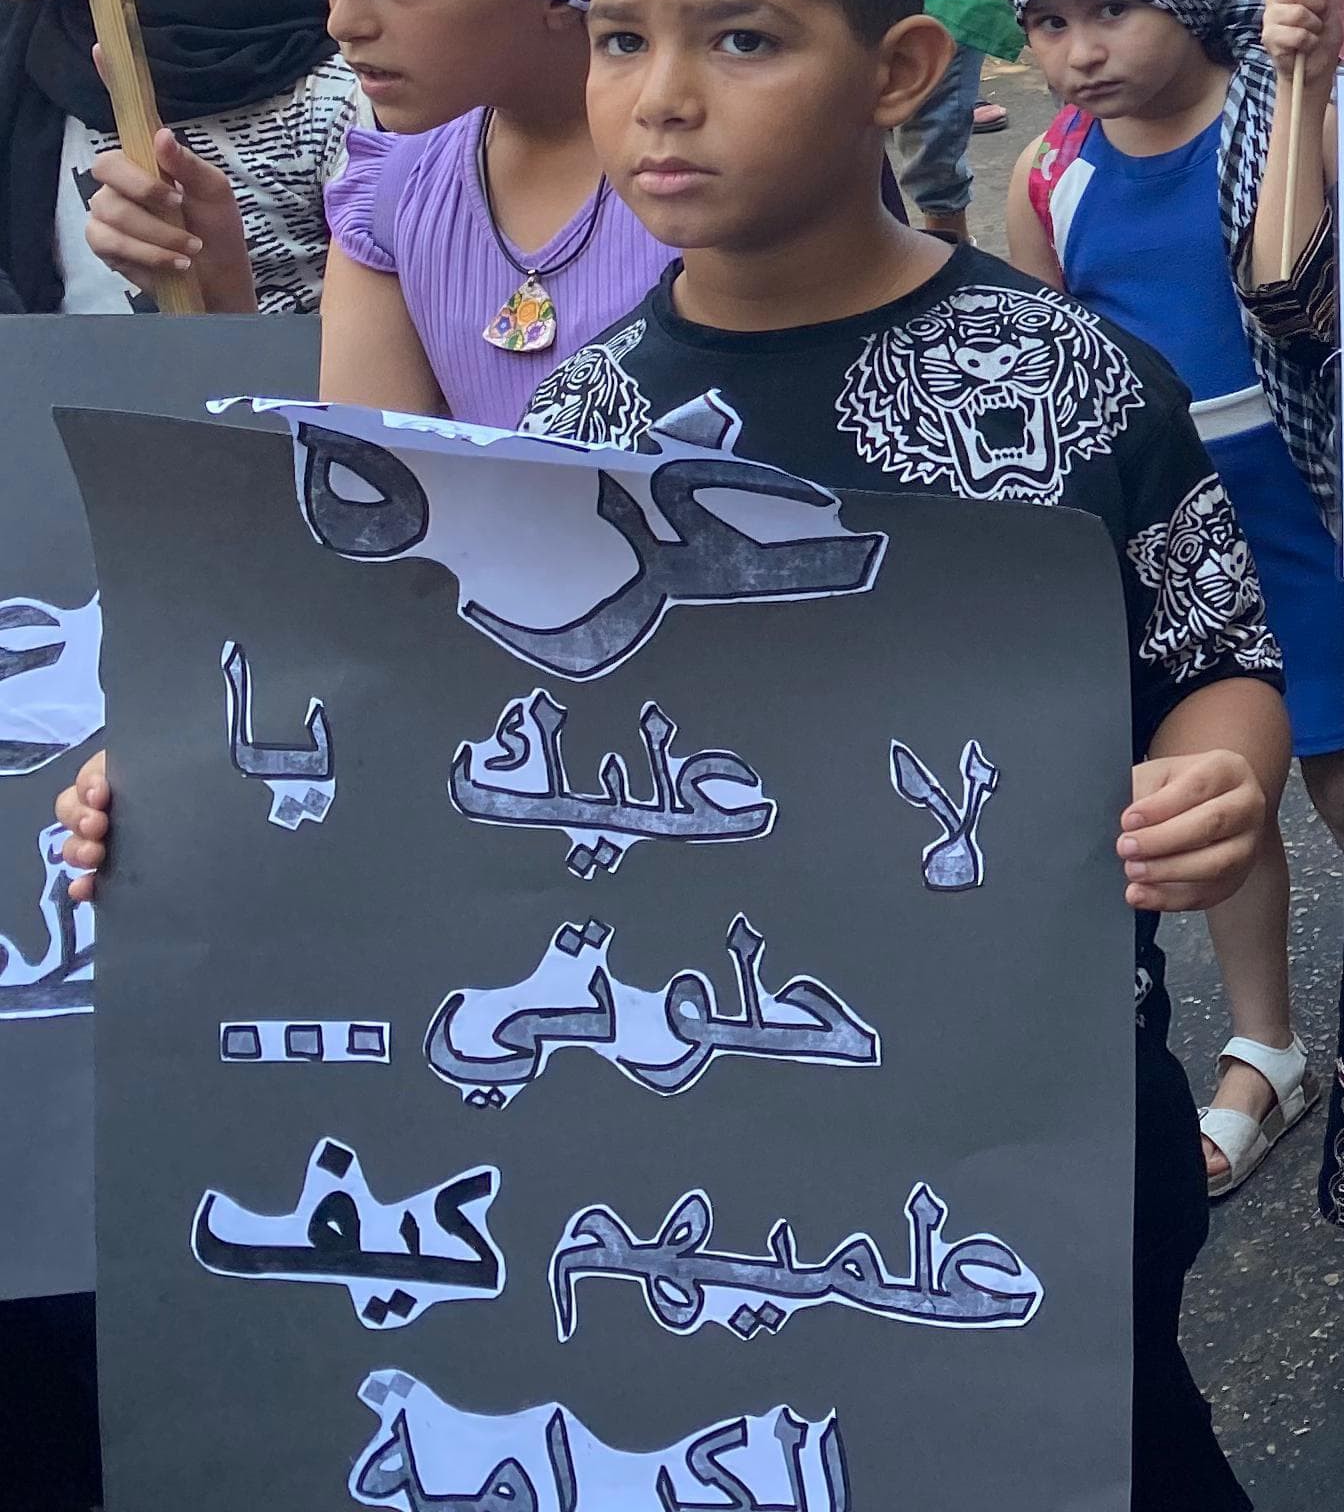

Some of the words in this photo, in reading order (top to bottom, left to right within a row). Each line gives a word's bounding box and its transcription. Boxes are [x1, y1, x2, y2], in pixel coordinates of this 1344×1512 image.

[222, 641, 334, 829] يا
[449, 689, 776, 879] عليك
[889, 738, 998, 890] لا
[424, 914, 880, 1110] حلوتي
[193, 1138, 504, 1326] كيف
[549, 1182, 1044, 1341] علميهم
